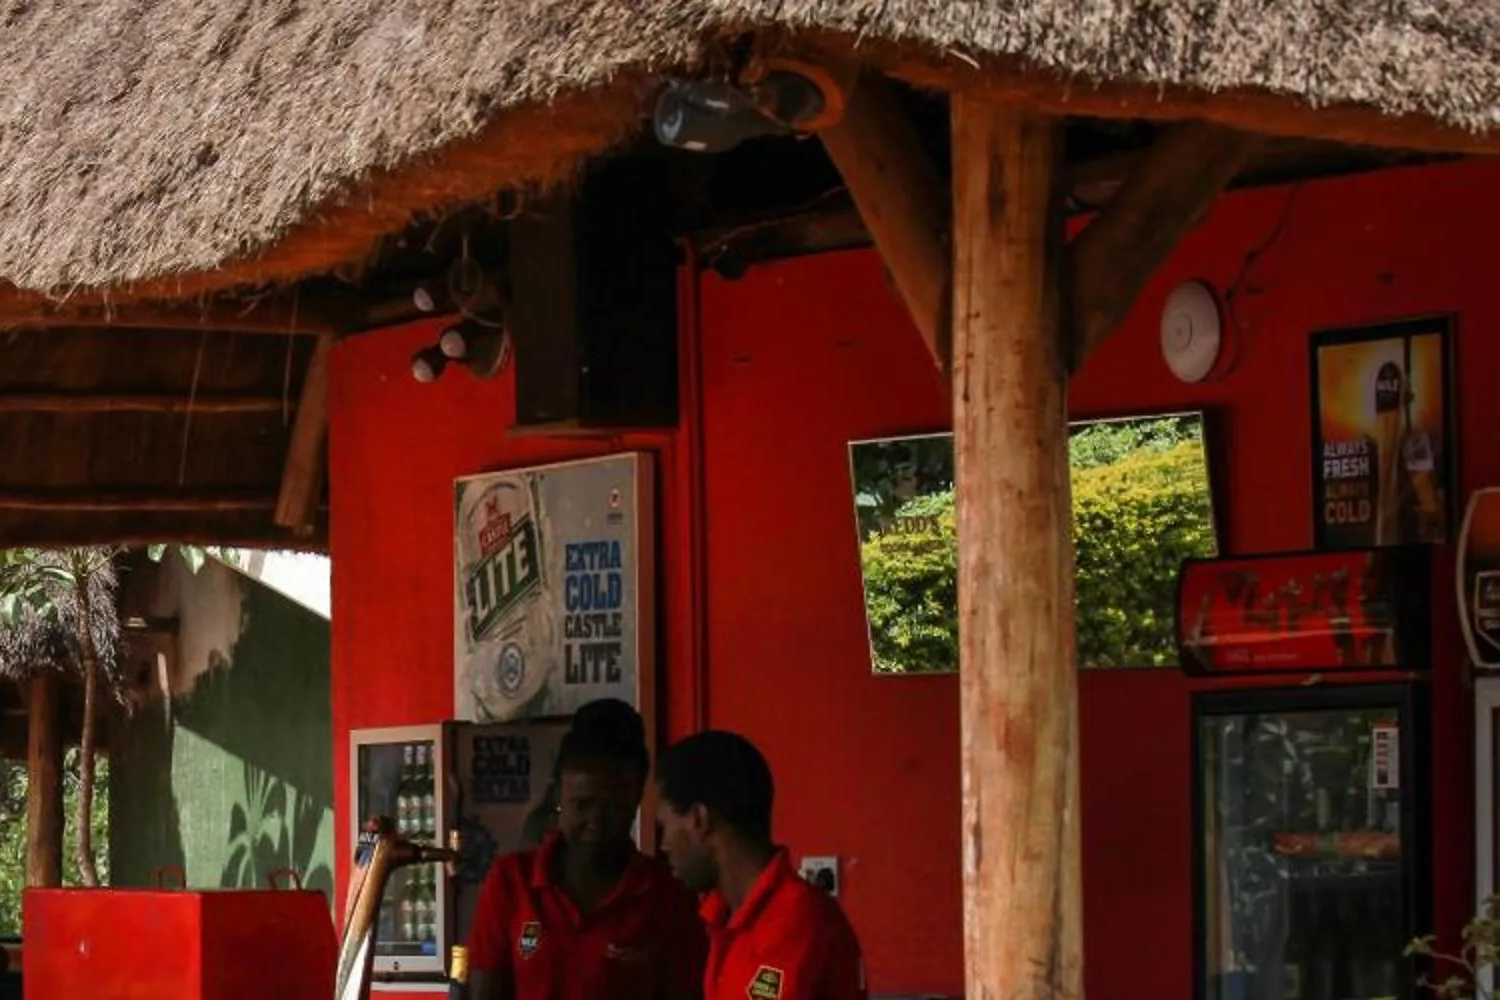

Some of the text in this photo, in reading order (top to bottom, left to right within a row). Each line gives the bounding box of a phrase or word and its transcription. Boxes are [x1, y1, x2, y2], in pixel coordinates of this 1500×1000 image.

[1323, 457, 1370, 480] FRESH
[1324, 500, 1371, 524] COLD
[565, 540, 622, 571] EXTRA
[474, 532, 530, 621] LITE
[565, 572, 622, 612] COLD
[564, 612, 622, 640] CASTLE
[564, 641, 622, 685] LITE
